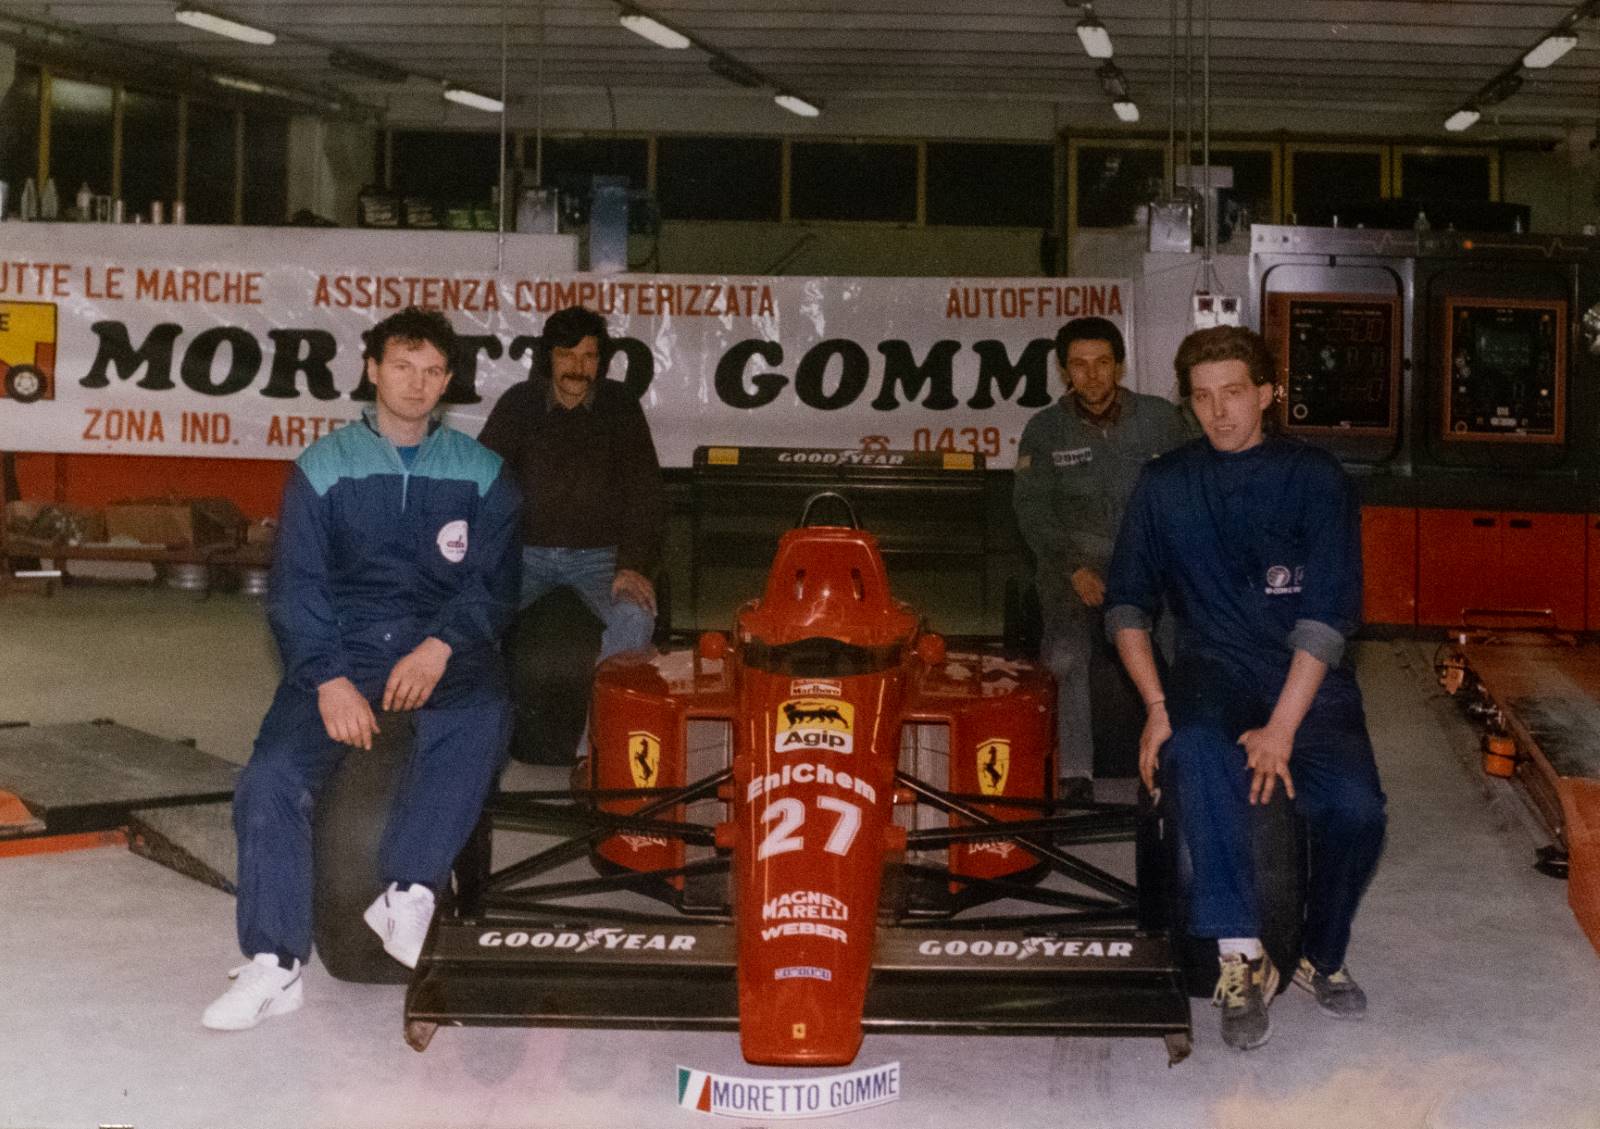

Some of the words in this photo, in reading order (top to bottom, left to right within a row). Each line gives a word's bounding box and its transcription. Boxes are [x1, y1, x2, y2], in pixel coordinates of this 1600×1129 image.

[84, 266, 124, 300] LE
[136, 269, 263, 304] MARCHE
[314, 275, 499, 312] ASSISTENZA
[515, 280, 775, 317] COMPUTERIZZATA
[946, 285, 1123, 319] AUTOFFICINA
[714, 337, 1057, 411] GOMM
[82, 408, 165, 442] ZONA
[181, 411, 239, 446] IND.
[783, 730, 846, 748] Agip
[758, 795, 862, 860] 27
[761, 922, 848, 944] WEBER
[713, 1080, 820, 1112] MORETTO
[830, 1068, 898, 1108] GOMME
